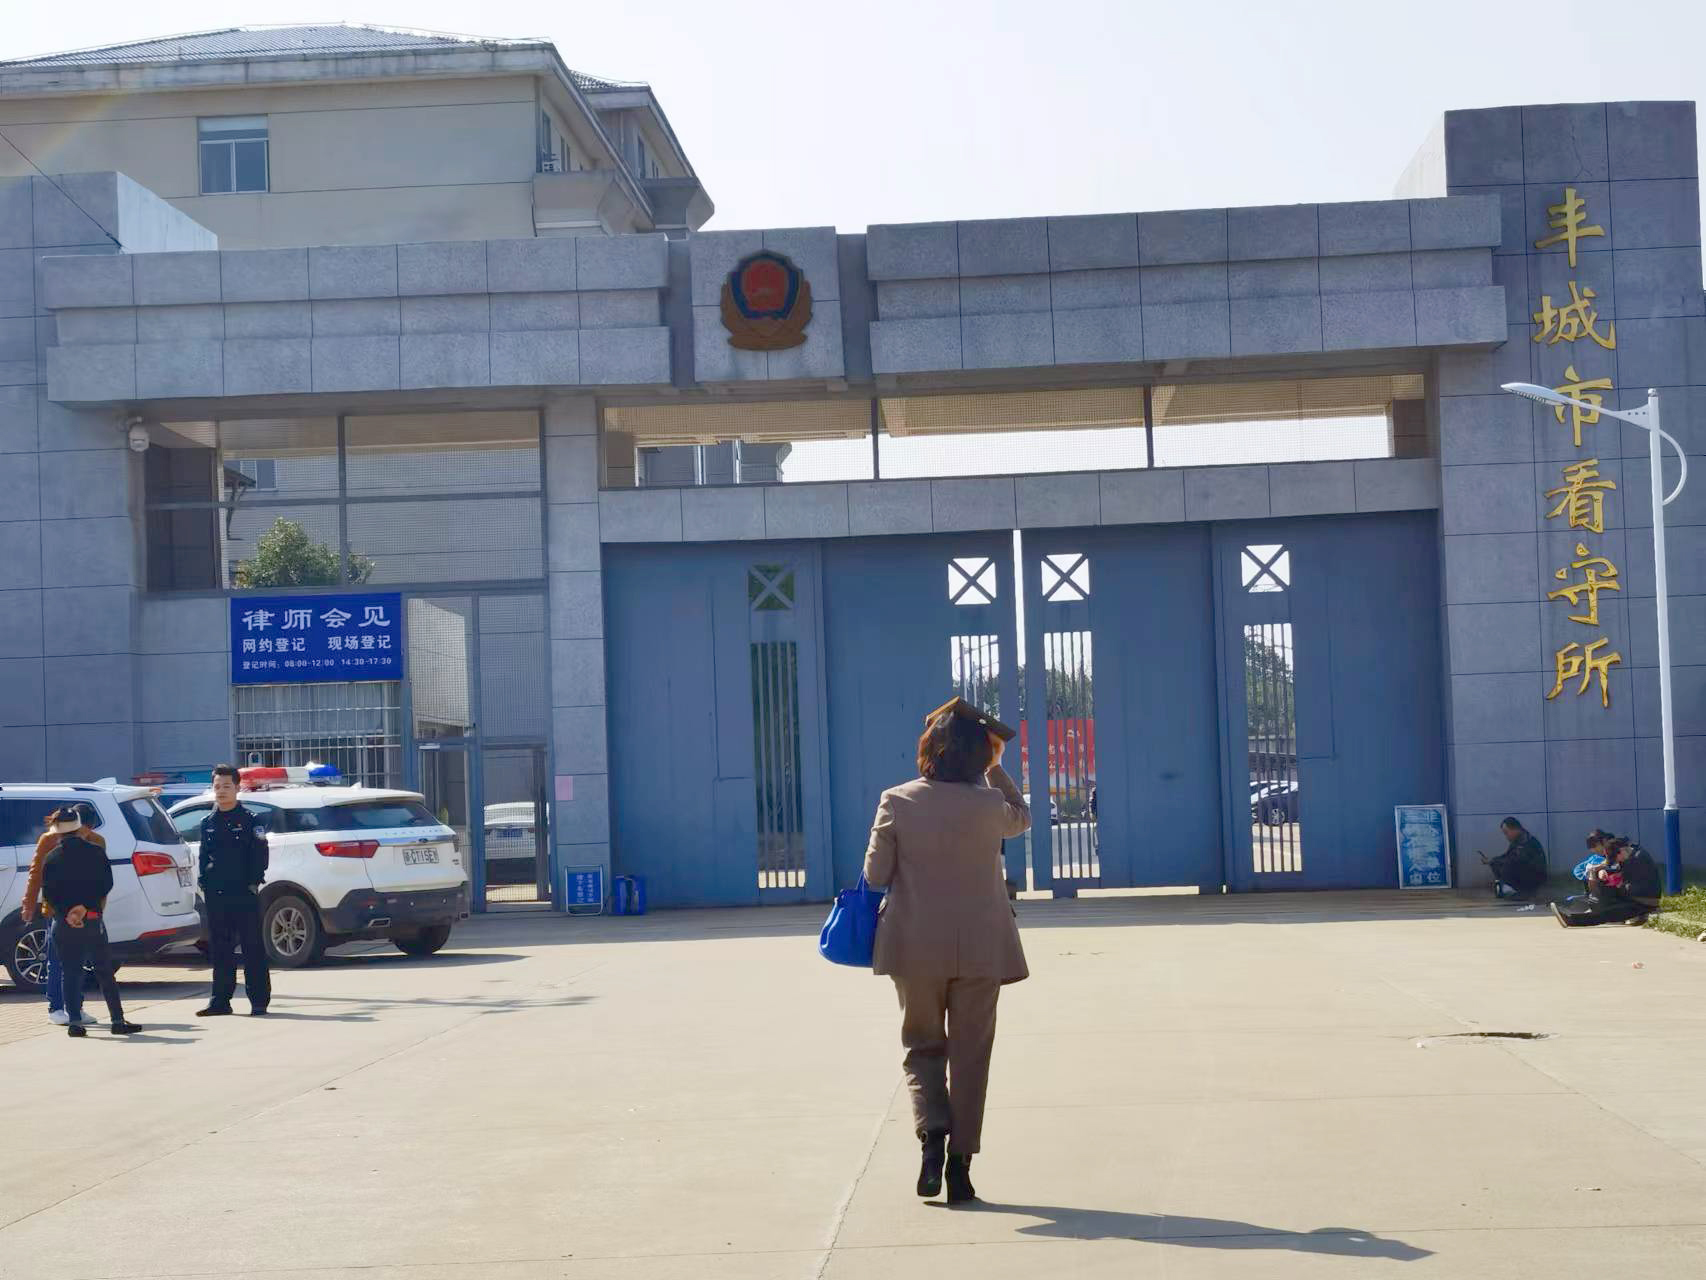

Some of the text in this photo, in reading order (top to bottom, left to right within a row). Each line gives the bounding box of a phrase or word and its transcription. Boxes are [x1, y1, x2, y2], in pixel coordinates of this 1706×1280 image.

[1533, 187, 1621, 709] 丰城市看守所
[242, 606, 391, 631] 律师会见
[243, 635, 392, 653] 网约登记 现场登记
